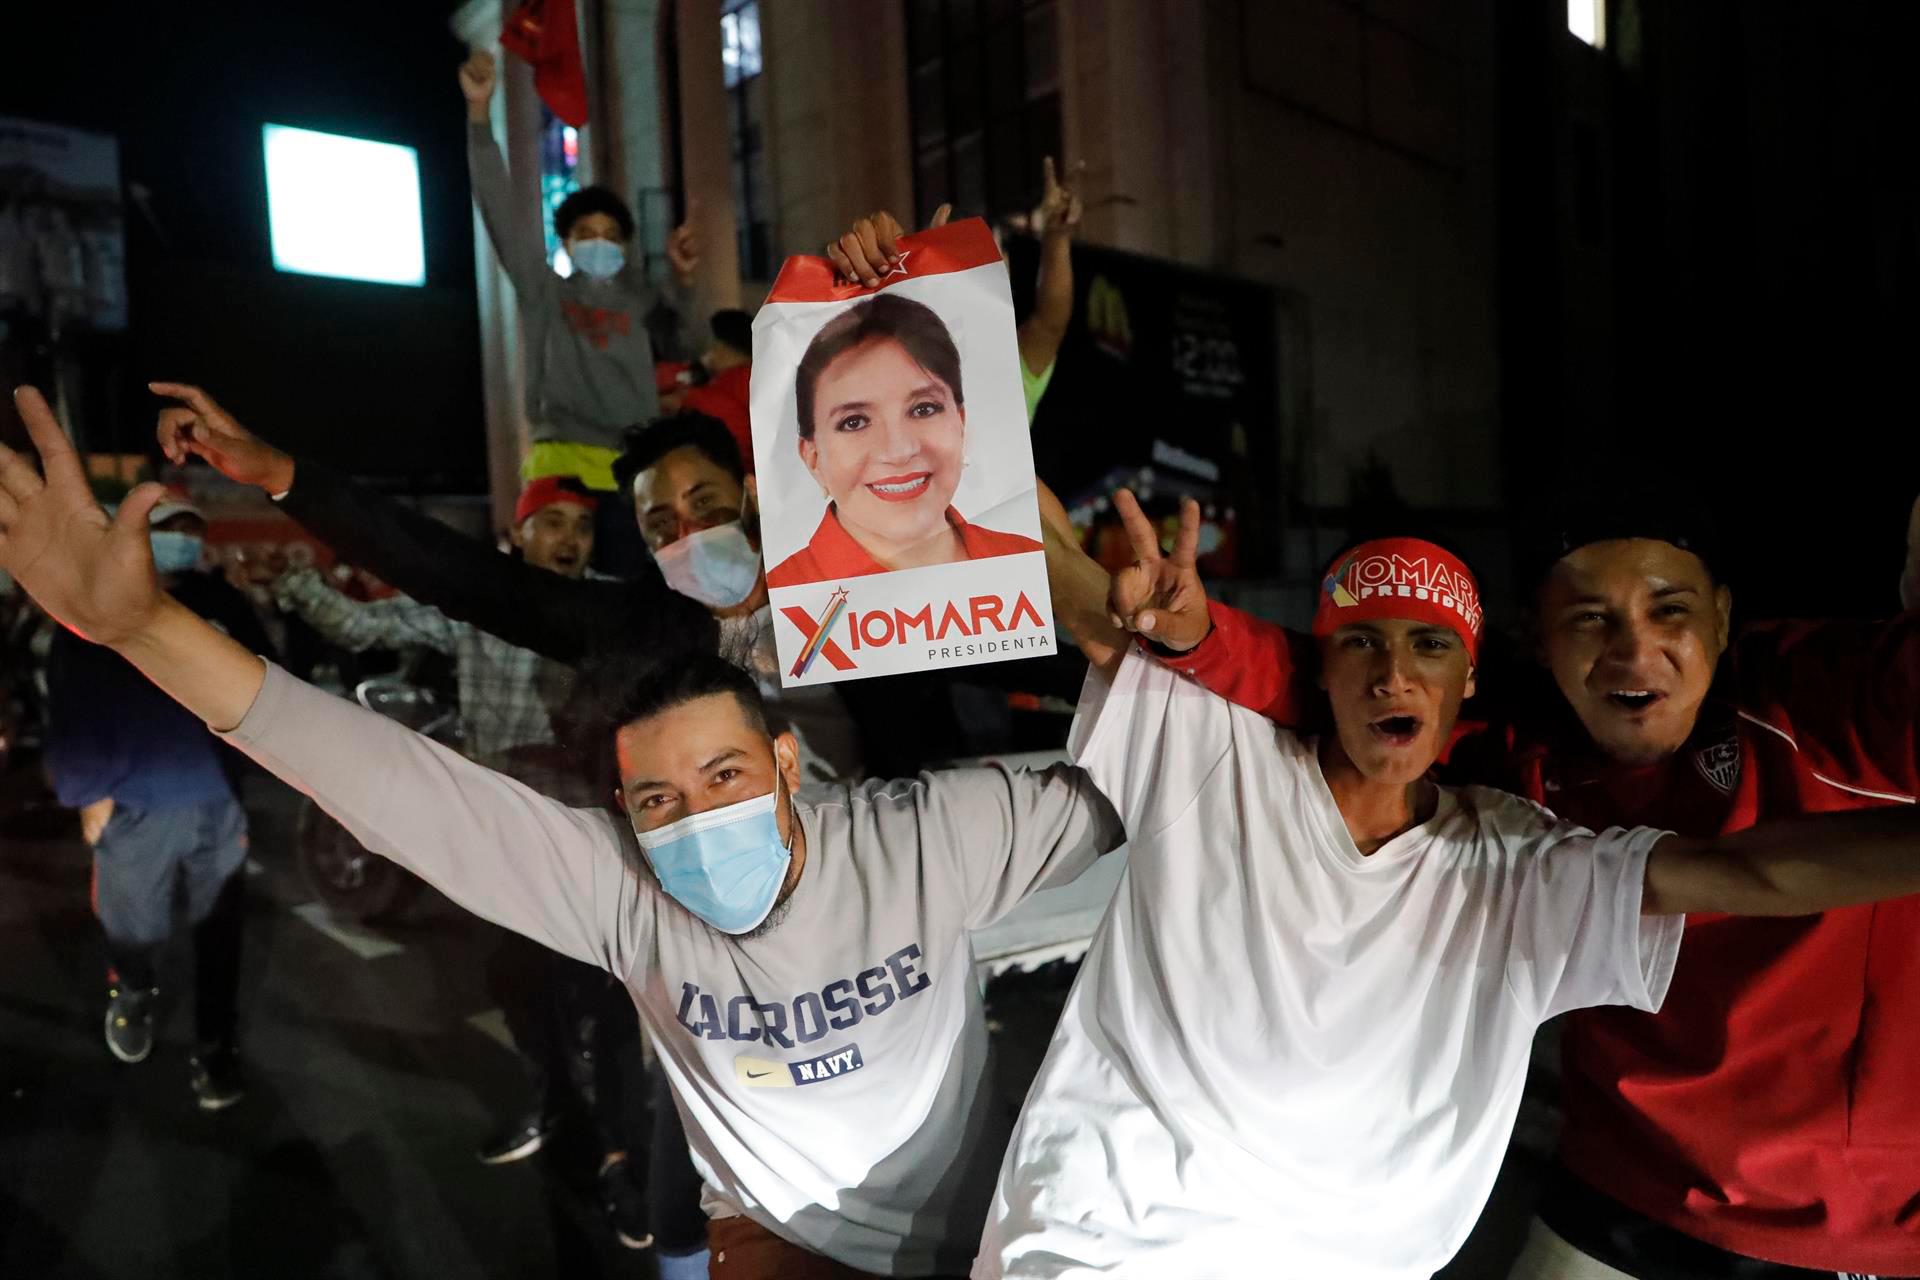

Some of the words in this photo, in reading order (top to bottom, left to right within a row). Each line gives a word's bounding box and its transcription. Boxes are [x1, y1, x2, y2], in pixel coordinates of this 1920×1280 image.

[779, 586, 1046, 679] XIOMARA
[928, 635, 1049, 660] PRESIDENTA
[676, 943, 932, 1049] LACROSSE
